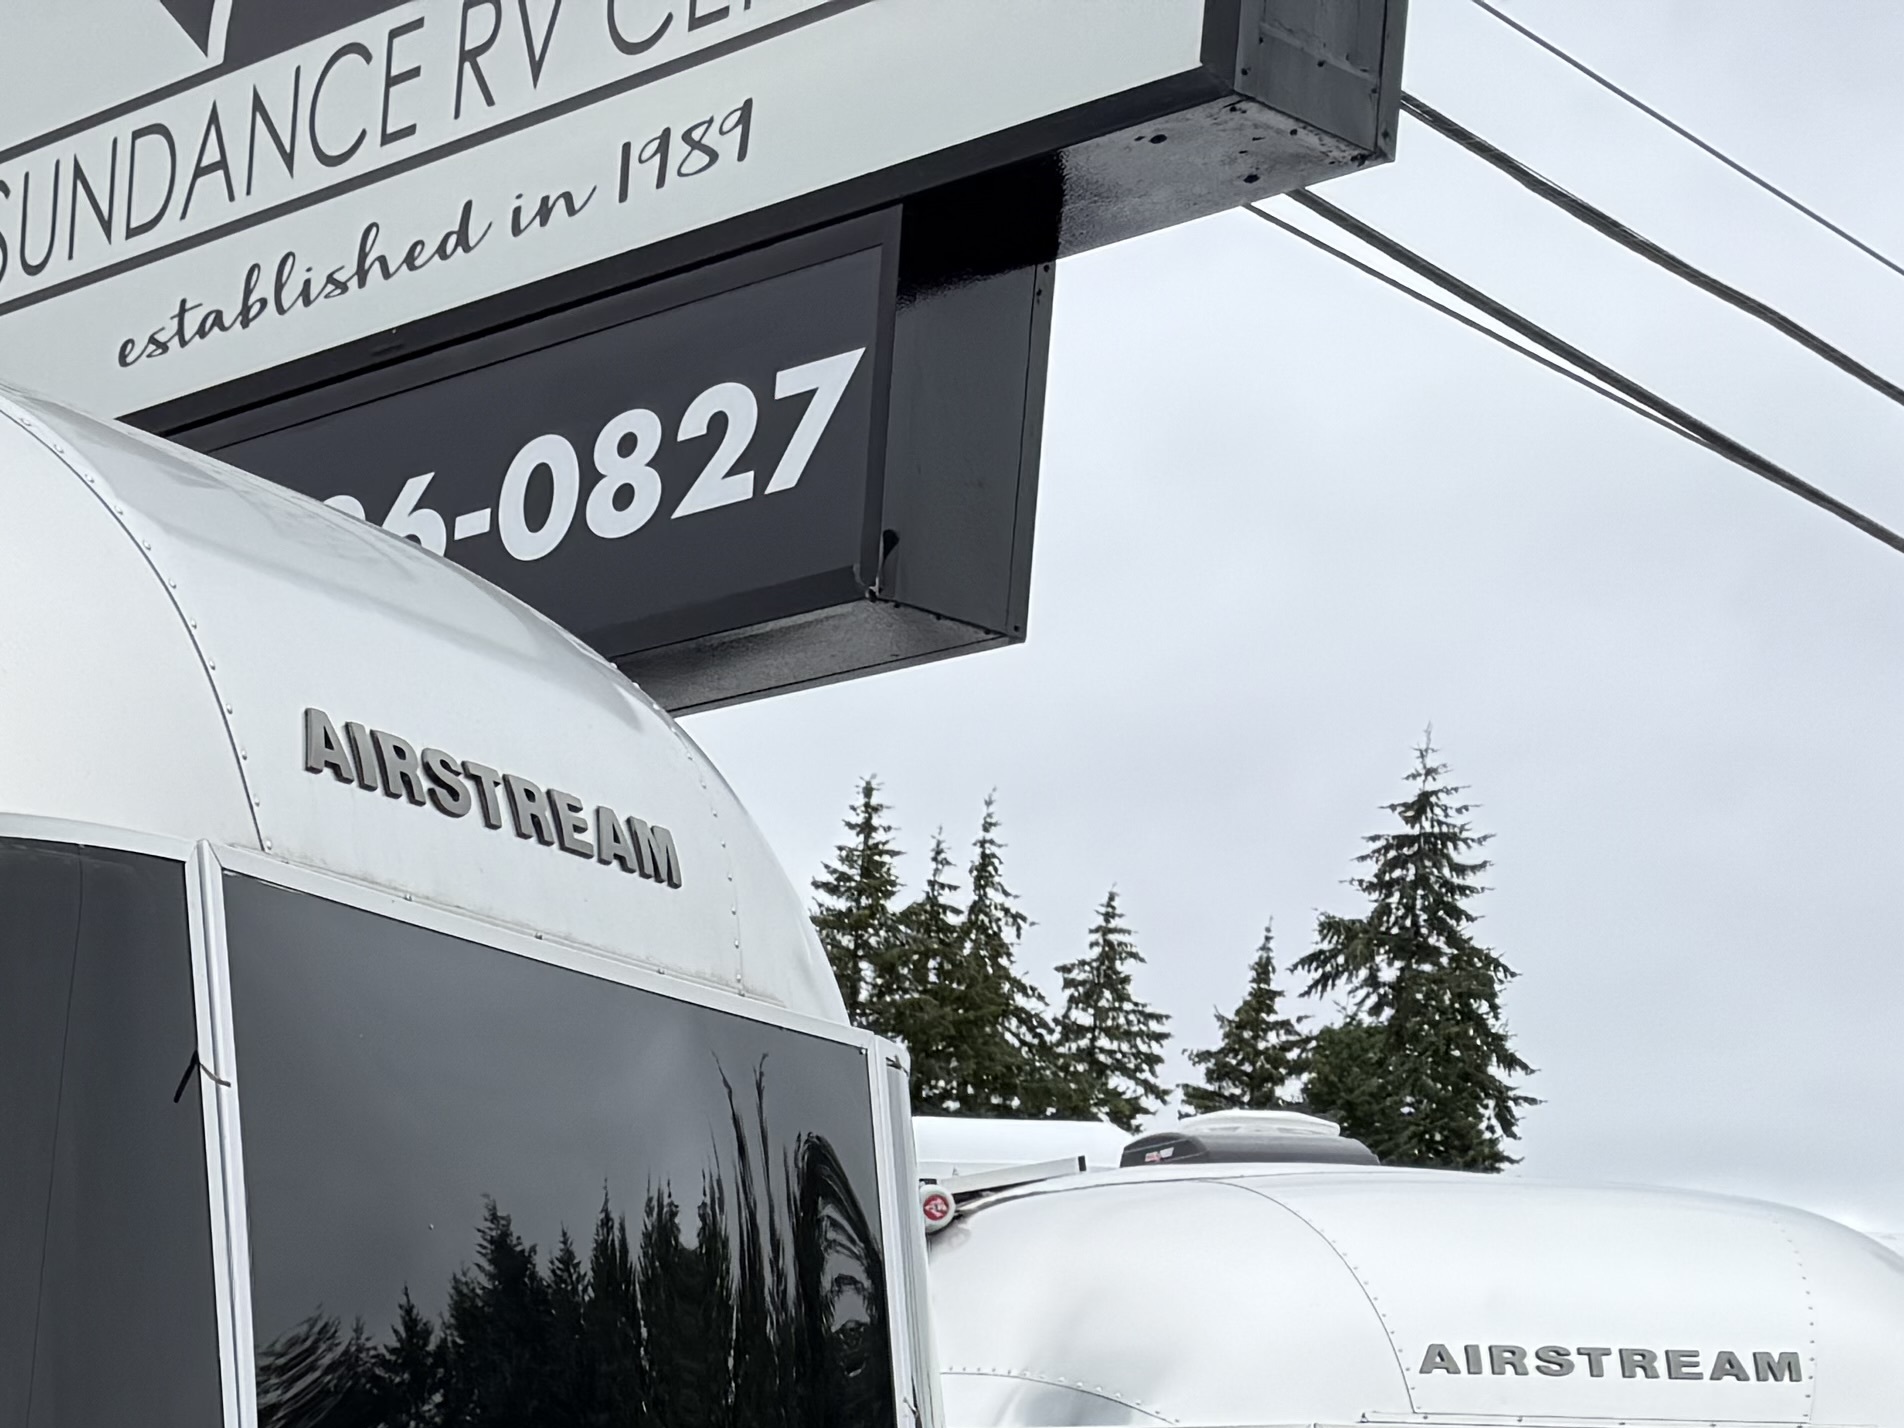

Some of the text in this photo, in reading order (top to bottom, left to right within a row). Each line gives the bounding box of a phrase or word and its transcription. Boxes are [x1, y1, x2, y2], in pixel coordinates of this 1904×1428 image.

[454, 0, 561, 120] RV
[118, 97, 753, 368] established in 1989
[324, 347, 866, 561] 6-0827
[303, 707, 682, 889] AIRSTREAM
[1419, 1343, 1803, 1382] AIRSTREAM
